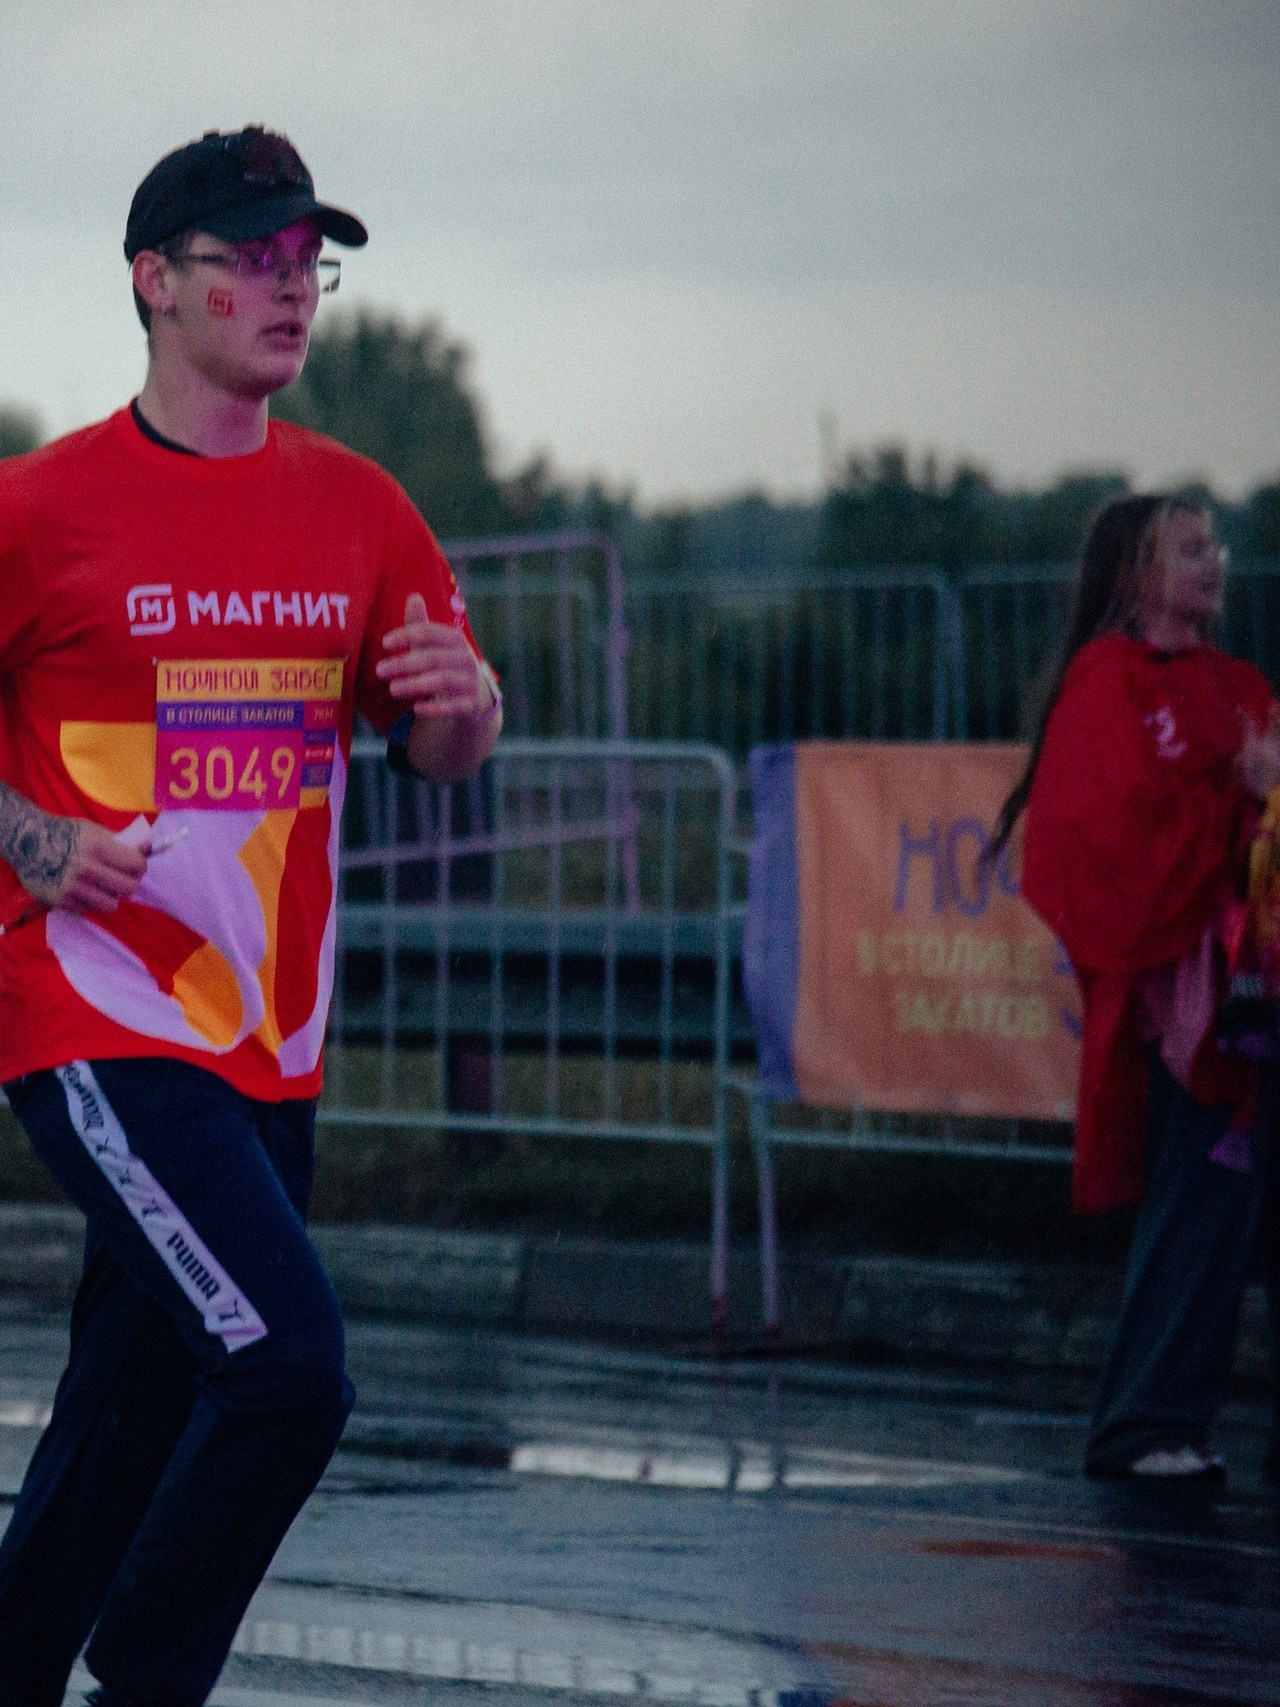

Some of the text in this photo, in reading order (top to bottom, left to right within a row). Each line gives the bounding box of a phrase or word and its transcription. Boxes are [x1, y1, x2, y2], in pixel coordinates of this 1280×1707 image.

[187, 590, 350, 630] МАГНИТ
[166, 665, 337, 694] НОЧНОЙ ЗАБЕГ
[166, 706, 294, 724] В СТОЛИЦЕ ЗАКАТОВ
[168, 746, 296, 800] 3049
[166, 1232, 220, 1300] PUMA
